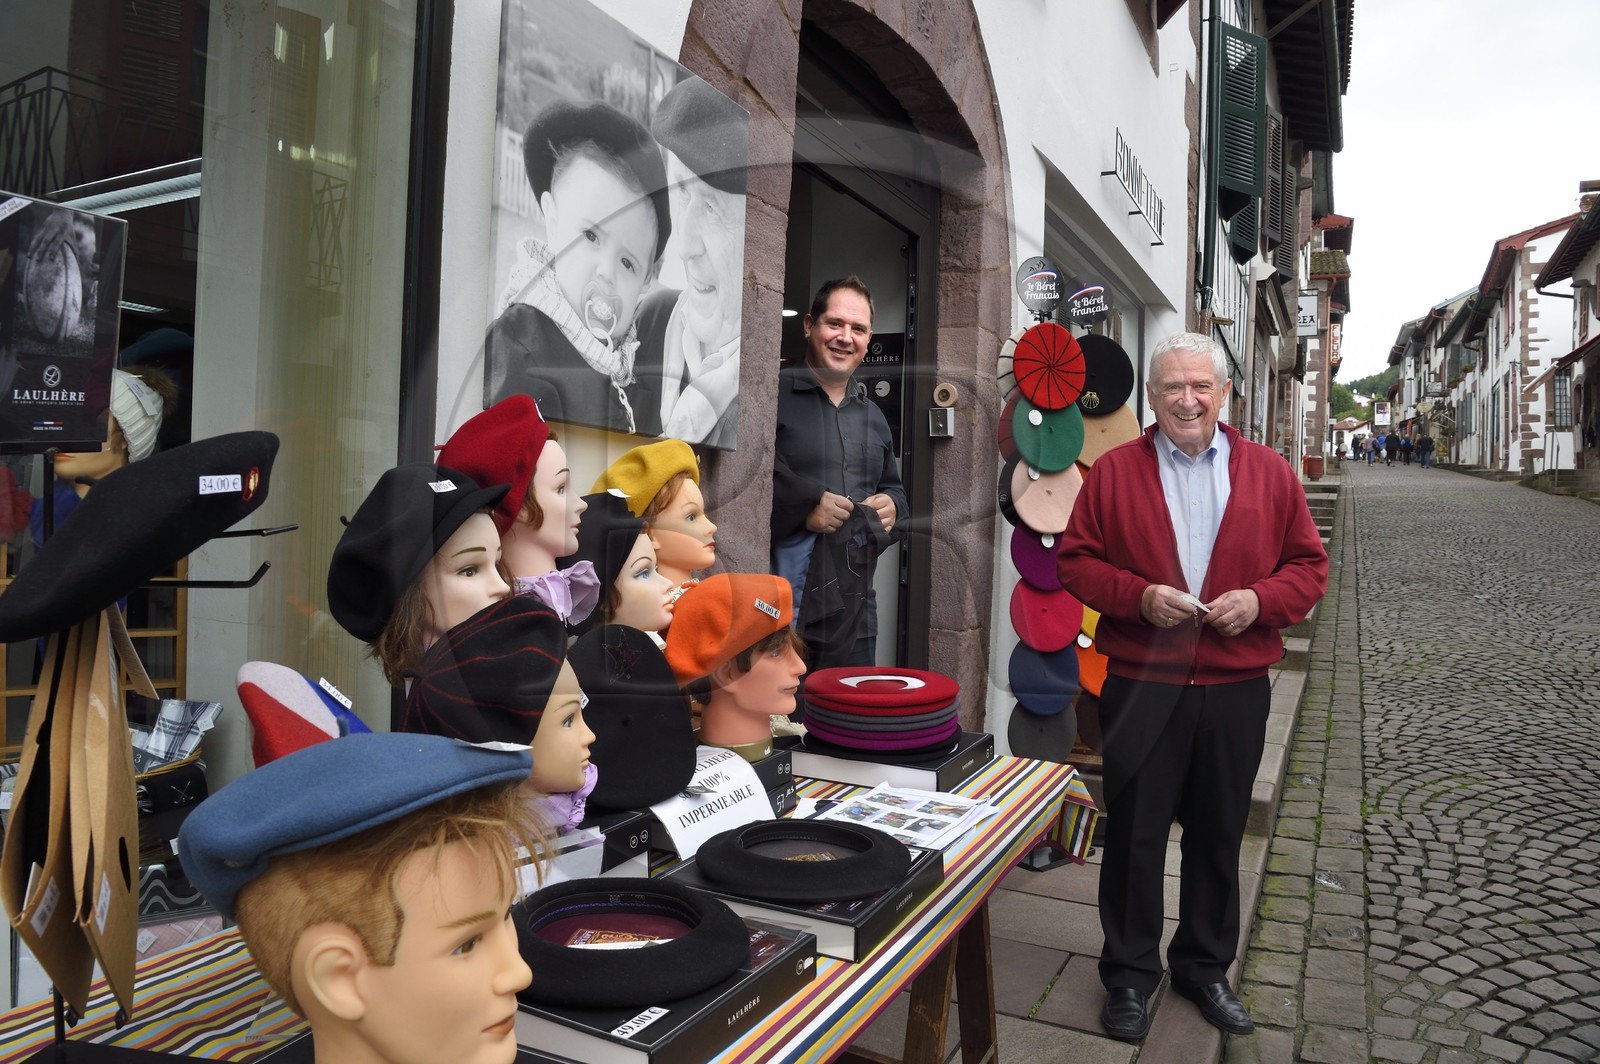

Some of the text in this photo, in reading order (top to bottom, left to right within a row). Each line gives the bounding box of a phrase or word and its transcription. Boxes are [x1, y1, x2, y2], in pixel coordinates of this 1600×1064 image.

[1115, 127, 1166, 240] BONNETERIE
[1028, 280, 1056, 292] Le Béret
[1024, 290, 1060, 301] Français
[1073, 295, 1105, 309] Le Béret
[1070, 303, 1109, 317] Français
[13, 389, 86, 402] LAULHÈRE
[201, 477, 240, 492] 34.00 €
[321, 680, 343, 701] 34.00
[694, 750, 737, 774] ULHERE
[678, 783, 755, 829] IMPERMEABLE
[727, 995, 761, 1026] LAULHÈRE
[616, 1006, 662, 1036] 49.00 €
